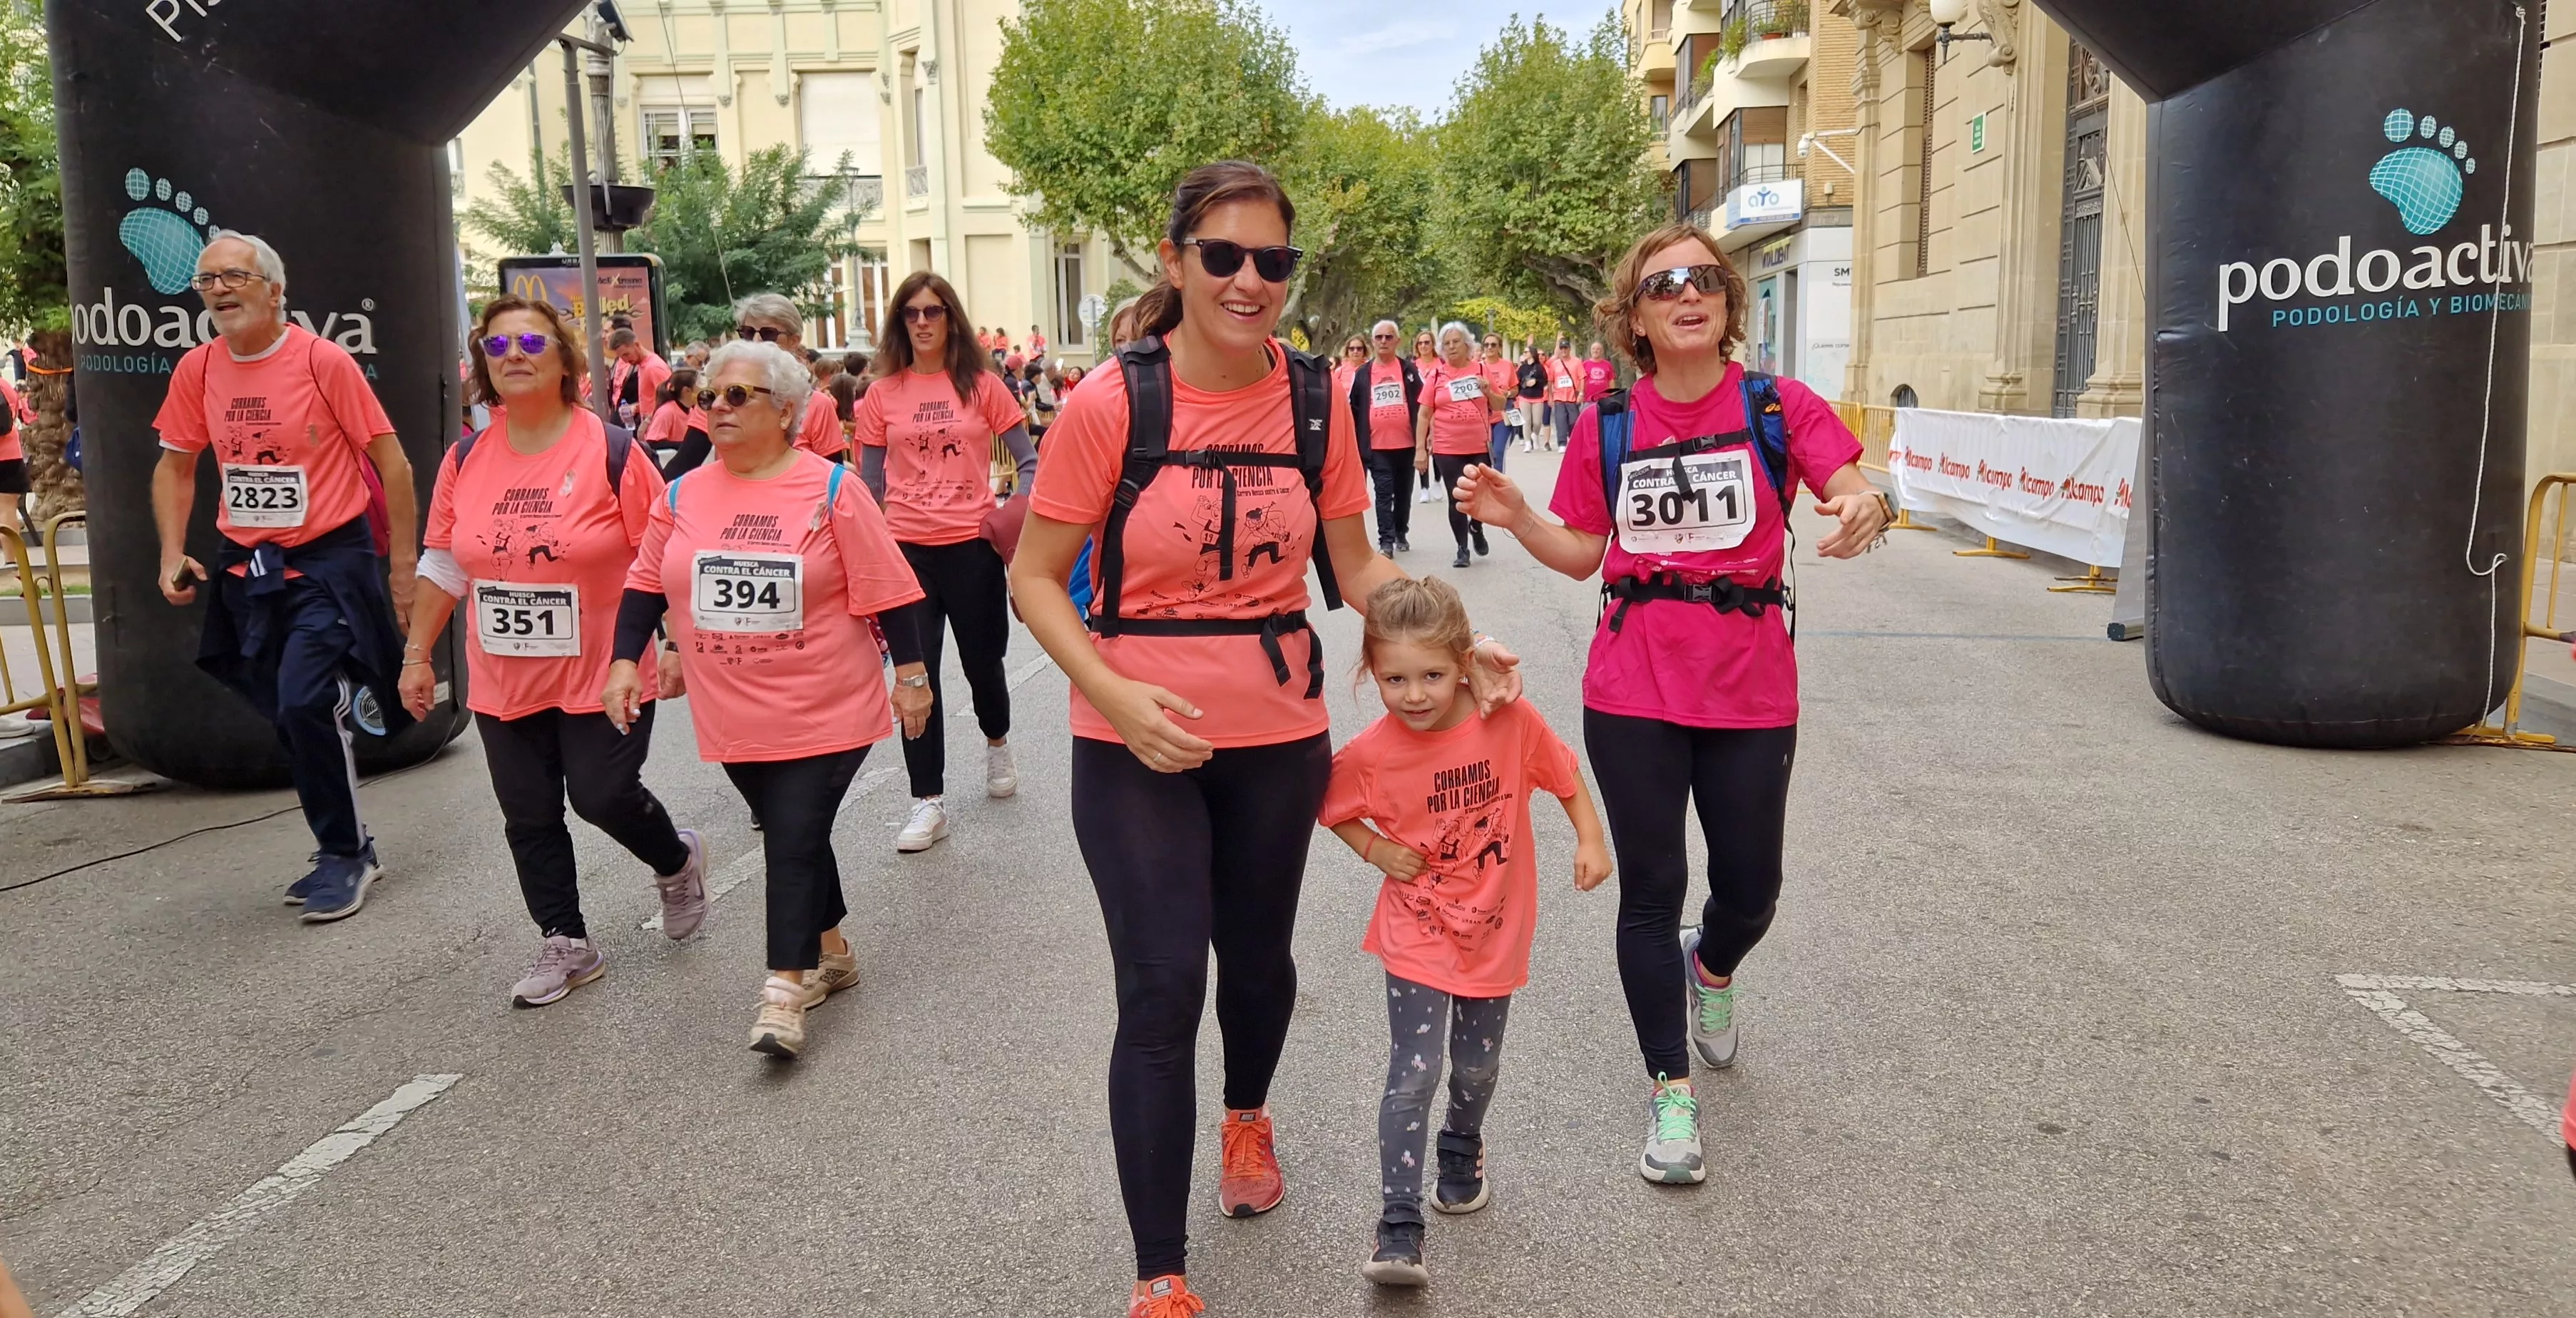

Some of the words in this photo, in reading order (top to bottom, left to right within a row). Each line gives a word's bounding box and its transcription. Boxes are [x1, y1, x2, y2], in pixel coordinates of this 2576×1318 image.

[2272, 295, 2420, 327] PODOLOGÍA
[2430, 297, 2442, 315] Y
[81, 352, 171, 374] PODOLOGÍA
[1376, 390, 1400, 400] 2902
[1454, 382, 1478, 394] 2903
[913, 413, 924, 424] POR
[925, 412, 931, 422] LA
[932, 409, 954, 421] CIENCIA
[919, 400, 949, 412] CORRAMOS
[1905, 446, 1932, 472] Alcampo
[1938, 452, 1970, 481] Alcampo
[1192, 466, 1213, 489] POR
[1632, 476, 1676, 489] CONTRA
[1692, 470, 1737, 484] CÁNCER
[1976, 459, 2012, 491] Alcampo
[2018, 466, 2054, 500] Alcampo
[230, 486, 299, 509] 2823
[504, 488, 549, 501] CORRAMOS
[2060, 474, 2104, 507] Alcampo
[492, 502, 510, 515] POR
[509, 501, 520, 514] LA
[521, 501, 553, 514] CIENCIA
[1632, 485, 1737, 526] 3011
[732, 514, 779, 528] CORRAMOS
[720, 528, 738, 540] POR
[737, 528, 748, 539] LA
[748, 528, 782, 542] CIENCIA
[704, 565, 740, 575] CONTRA
[742, 566, 752, 575] EL
[753, 566, 791, 577] CÁNCER
[483, 595, 516, 605] CONTRA
[530, 596, 567, 606] CÁNCER
[714, 579, 780, 609] 394
[492, 608, 554, 635] 351
[1434, 759, 1491, 792] CORRAMOS
[1427, 792, 1447, 814] POR
[1449, 789, 1460, 810] LA
[1463, 776, 1499, 807] CIENCIA
[1152, 1279, 1170, 1293] NIKE
